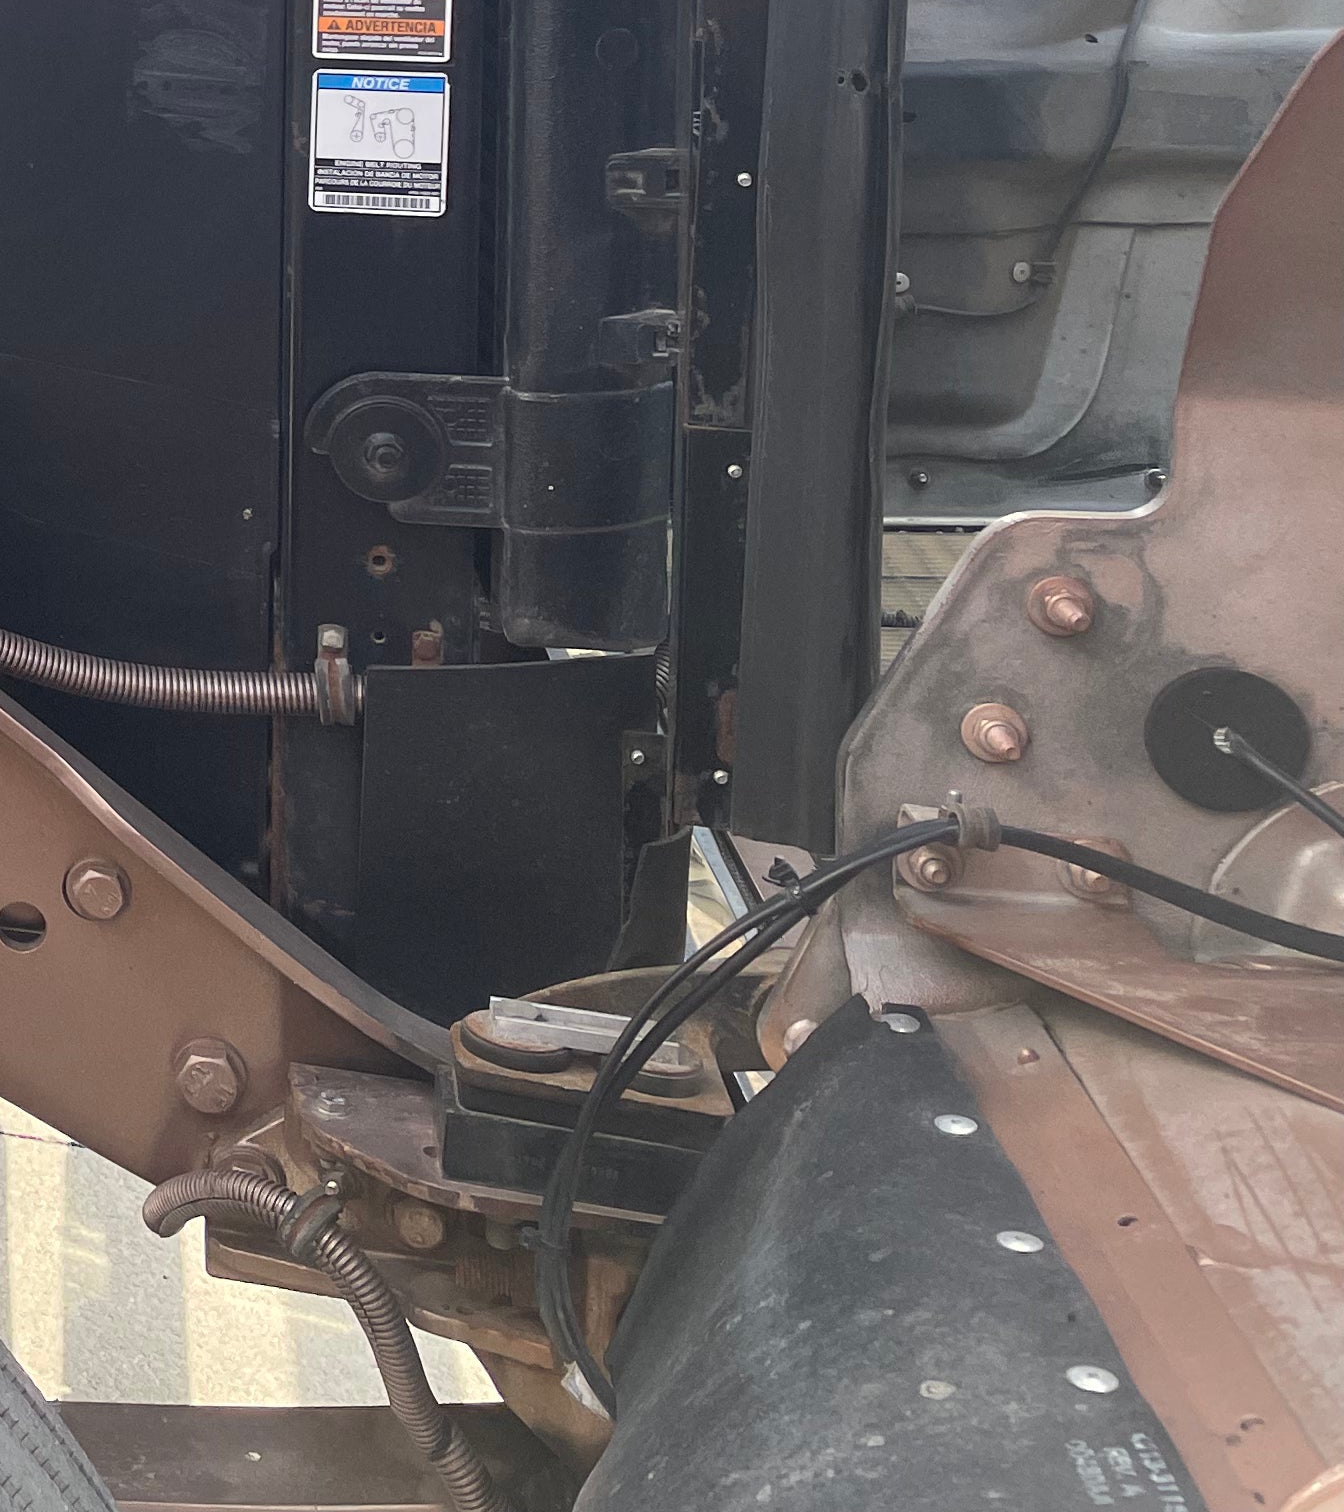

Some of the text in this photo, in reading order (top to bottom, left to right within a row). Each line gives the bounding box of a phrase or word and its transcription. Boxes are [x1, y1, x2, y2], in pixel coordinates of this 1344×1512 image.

[346, 20, 436, 34] ADVERTENCIA
[352, 77, 410, 90] NOTICE
[386, 161, 422, 170] ROUTING
